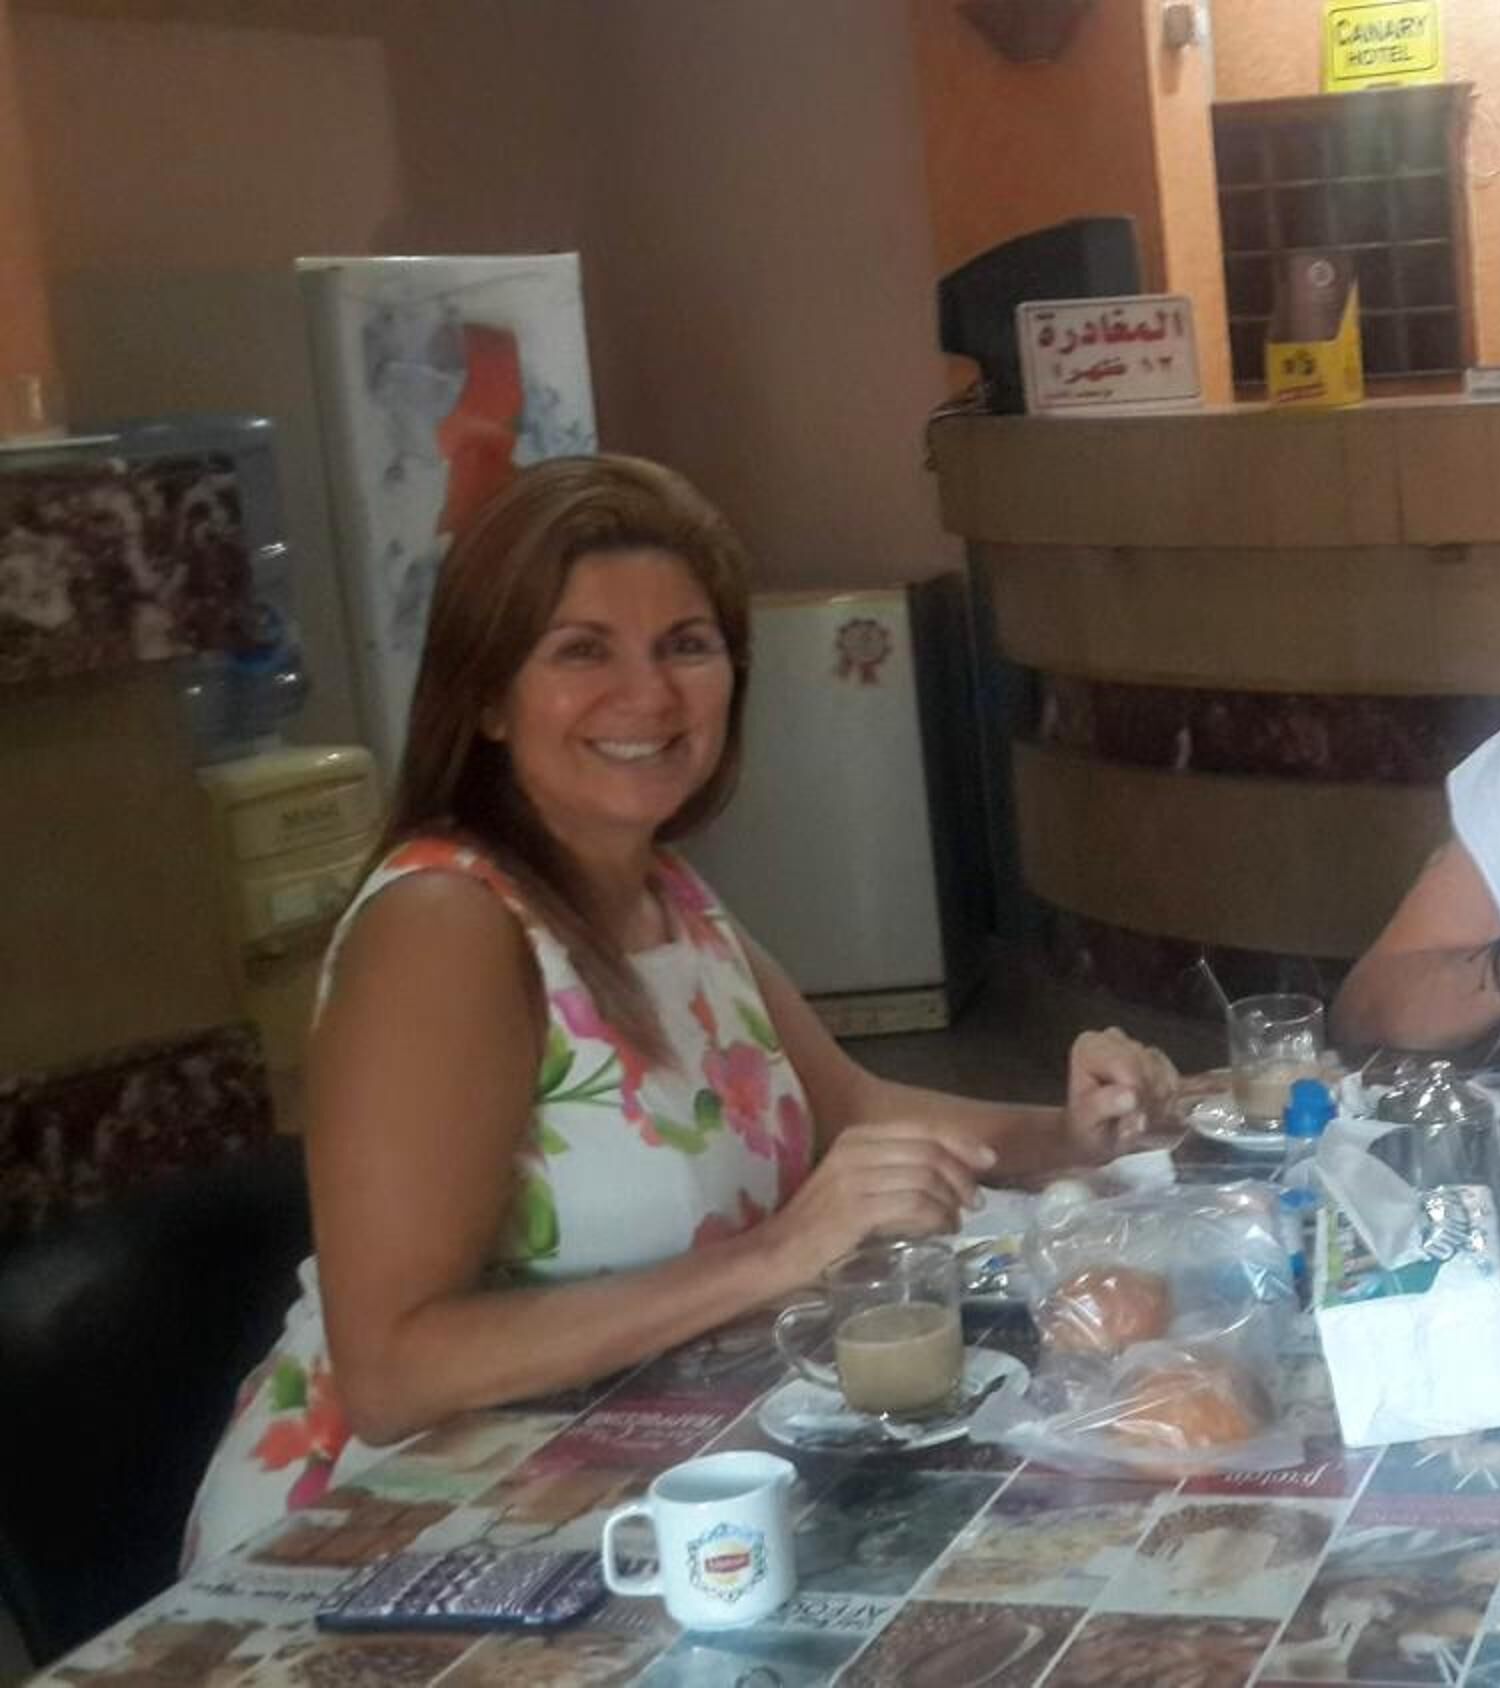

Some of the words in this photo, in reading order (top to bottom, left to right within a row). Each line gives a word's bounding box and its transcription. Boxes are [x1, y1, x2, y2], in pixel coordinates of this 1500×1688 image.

[1346, 45, 1414, 66] HOTEL
[1036, 309, 1183, 354] المغادرة
[1224, 1463, 1329, 1488] protein
